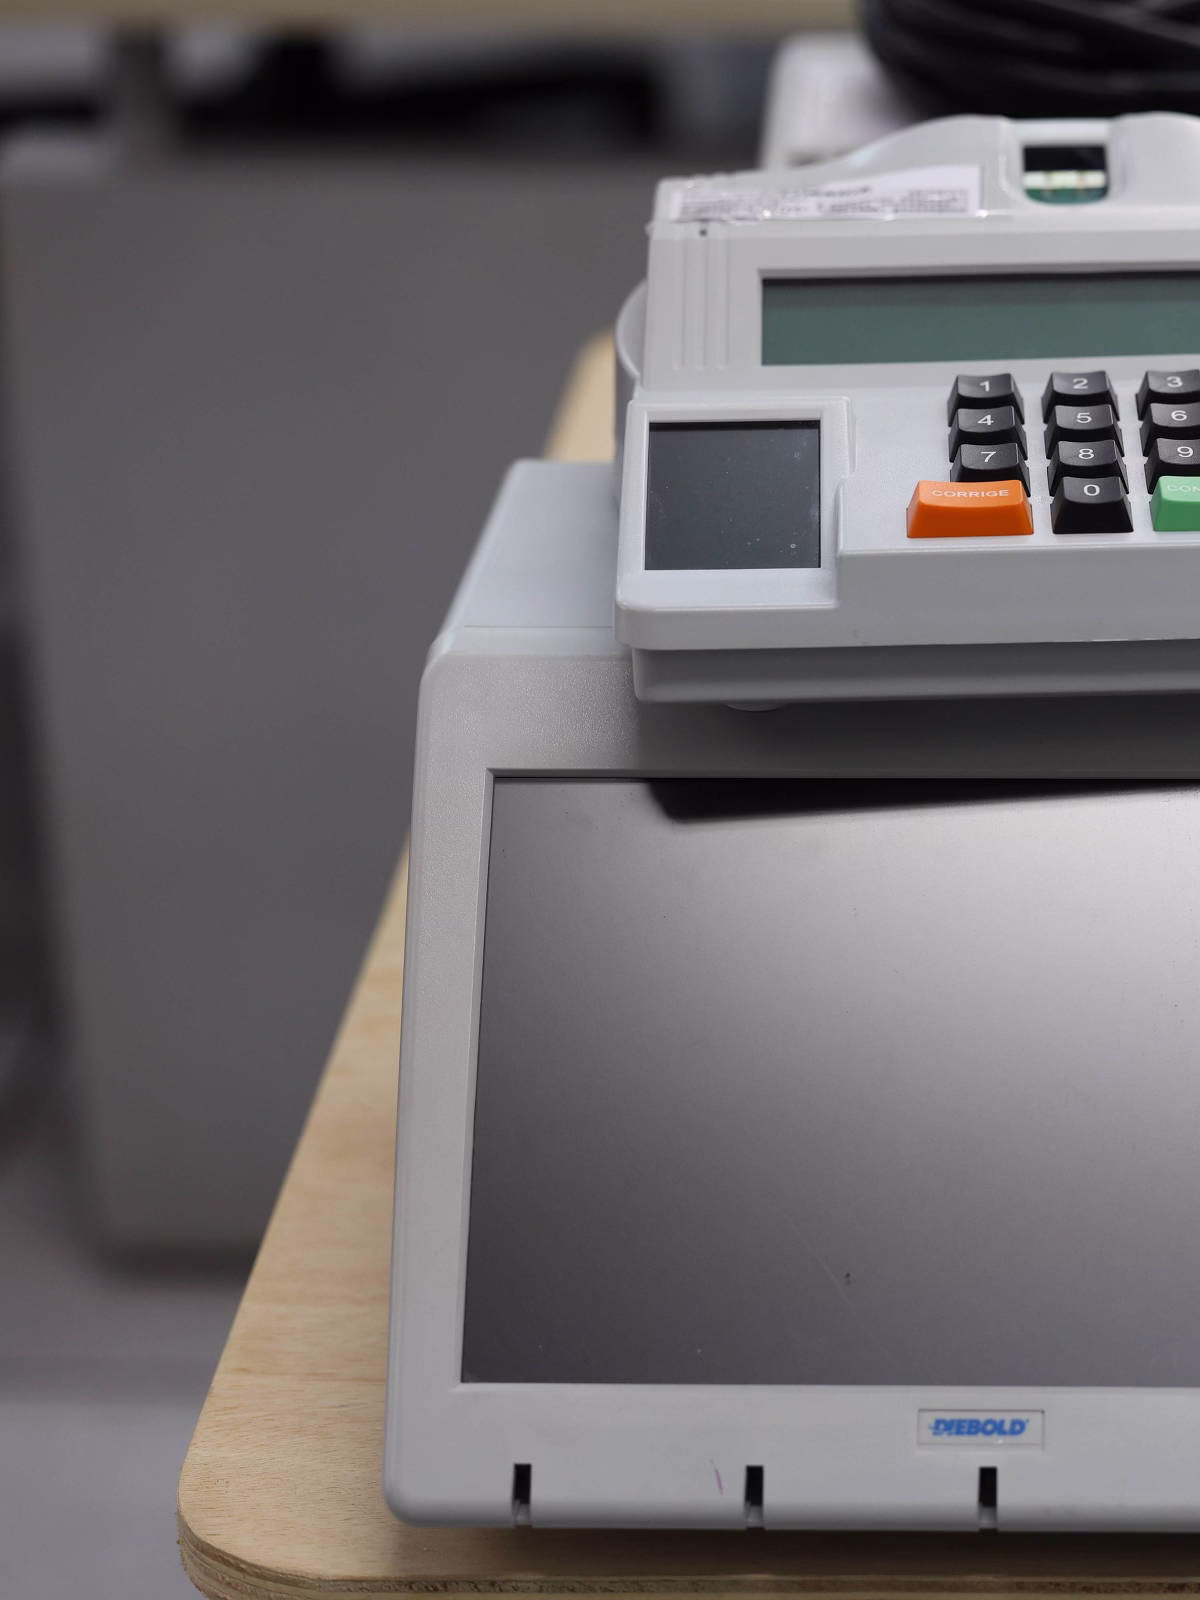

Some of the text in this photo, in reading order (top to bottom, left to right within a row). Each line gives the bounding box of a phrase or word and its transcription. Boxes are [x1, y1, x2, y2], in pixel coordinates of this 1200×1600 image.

[979, 376, 1183, 392] 1 2 3
[977, 410, 1187, 426] 4 5 6
[980, 446, 1194, 463] 7 8 9
[932, 489, 1009, 498] CORRIGE
[1083, 484, 1100, 497] 0
[930, 1418, 1030, 1437] DIEBOLD
